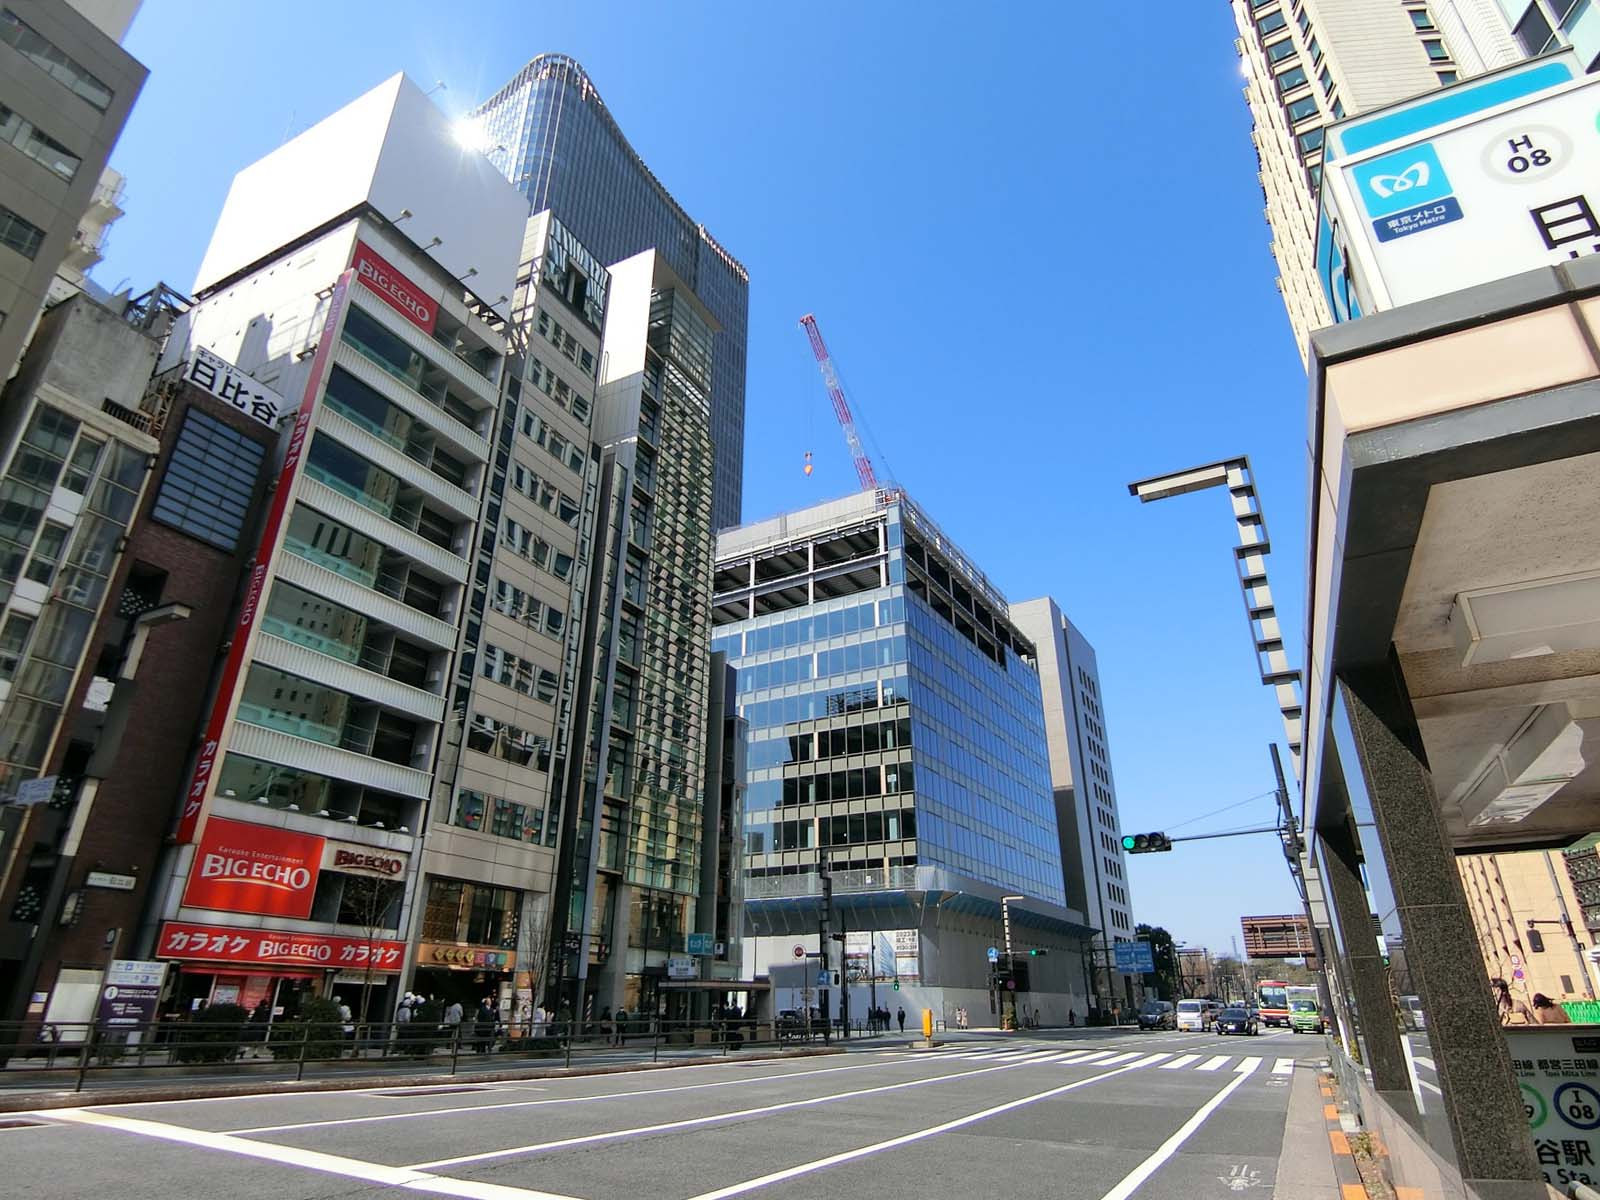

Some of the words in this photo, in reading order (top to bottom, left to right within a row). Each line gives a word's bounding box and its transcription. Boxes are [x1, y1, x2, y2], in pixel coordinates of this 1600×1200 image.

[1508, 134, 1533, 153] H
[1508, 149, 1551, 173] 08
[1386, 205, 1446, 229] 東京メトロ
[1393, 222, 1419, 234] Tokyo
[1419, 214, 1446, 227] Metro
[358, 259, 388, 289] BIG
[390, 283, 430, 321] ECHO
[190, 358, 278, 425] 日比谷
[186, 740, 217, 817] カラオケ
[252, 850, 304, 864] Entertainment
[334, 849, 364, 866] BIG
[365, 855, 402, 874] ECHO
[201, 853, 249, 877] BIG
[251, 862, 311, 889] ECHO
[167, 931, 250, 954] カラオケ
[258, 940, 290, 957] BIG
[290, 943, 332, 961] ECHO
[339, 944, 400, 963] カラオケ
[1569, 1104, 1595, 1119] 08
[1557, 1168, 1598, 1185] Sta.
